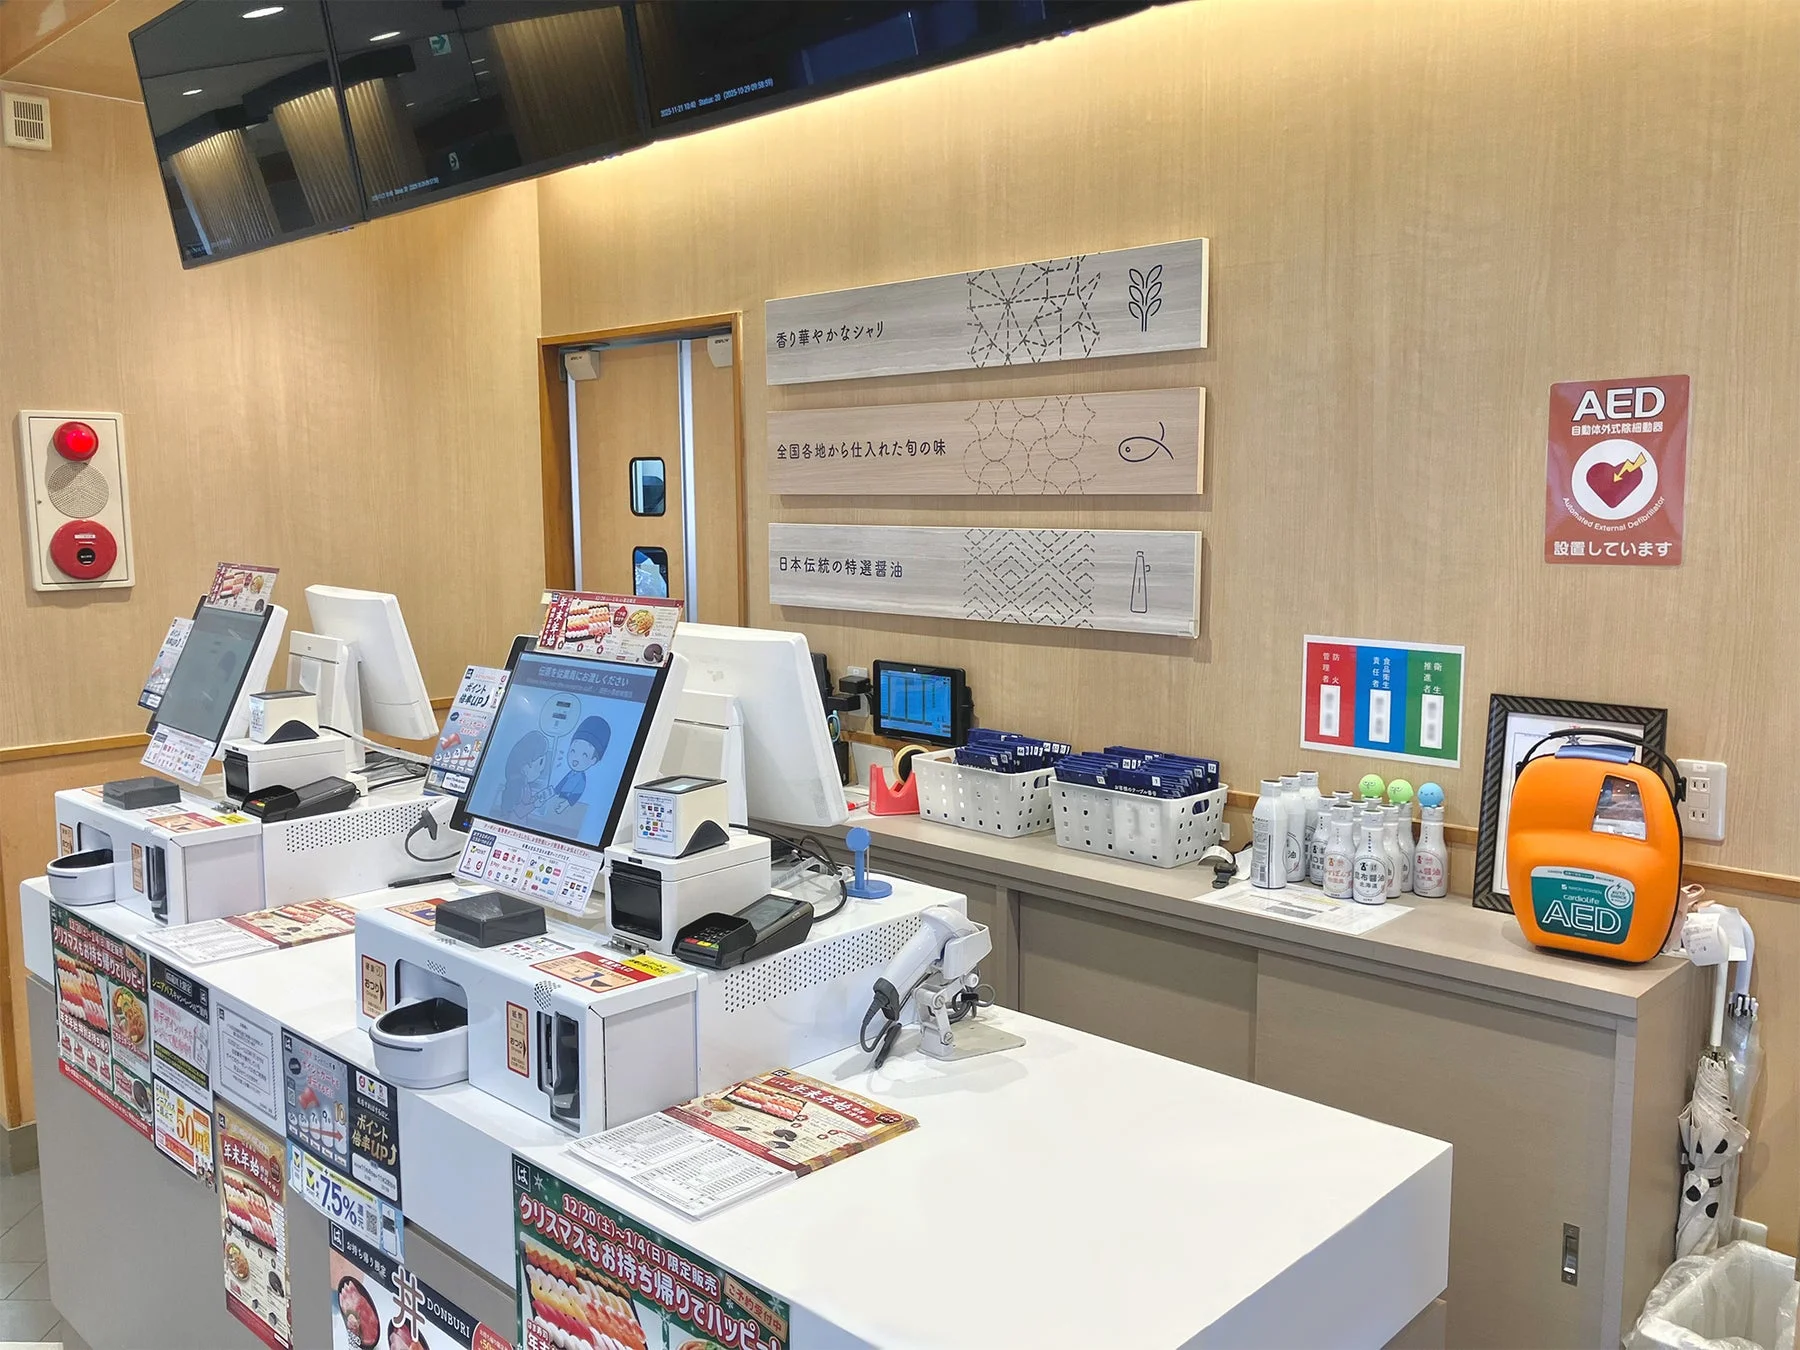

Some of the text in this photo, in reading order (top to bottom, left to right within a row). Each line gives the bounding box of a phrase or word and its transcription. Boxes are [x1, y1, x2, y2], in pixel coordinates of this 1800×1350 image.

[776, 320, 884, 349] 香り華やかなシャリ
[1571, 386, 1666, 422] AED
[1571, 421, 1664, 436] 自動体外式除細動器
[777, 438, 946, 460] 全国各地から仕入れた旬の味
[1563, 497, 1593, 528] Automated
[1594, 523, 1626, 532] External
[1553, 541, 1673, 556] 設置しています
[779, 556, 903, 578] 日本伝統の特選醤油
[1541, 899, 1621, 935] AED
[357, 1114, 388, 1142] ポイント
[223, 1140, 260, 1177] 年末年始
[320, 1174, 357, 1226] 7.5%
[426, 1298, 471, 1339] DONBURI
[728, 1282, 783, 1333] ご予約受付中
